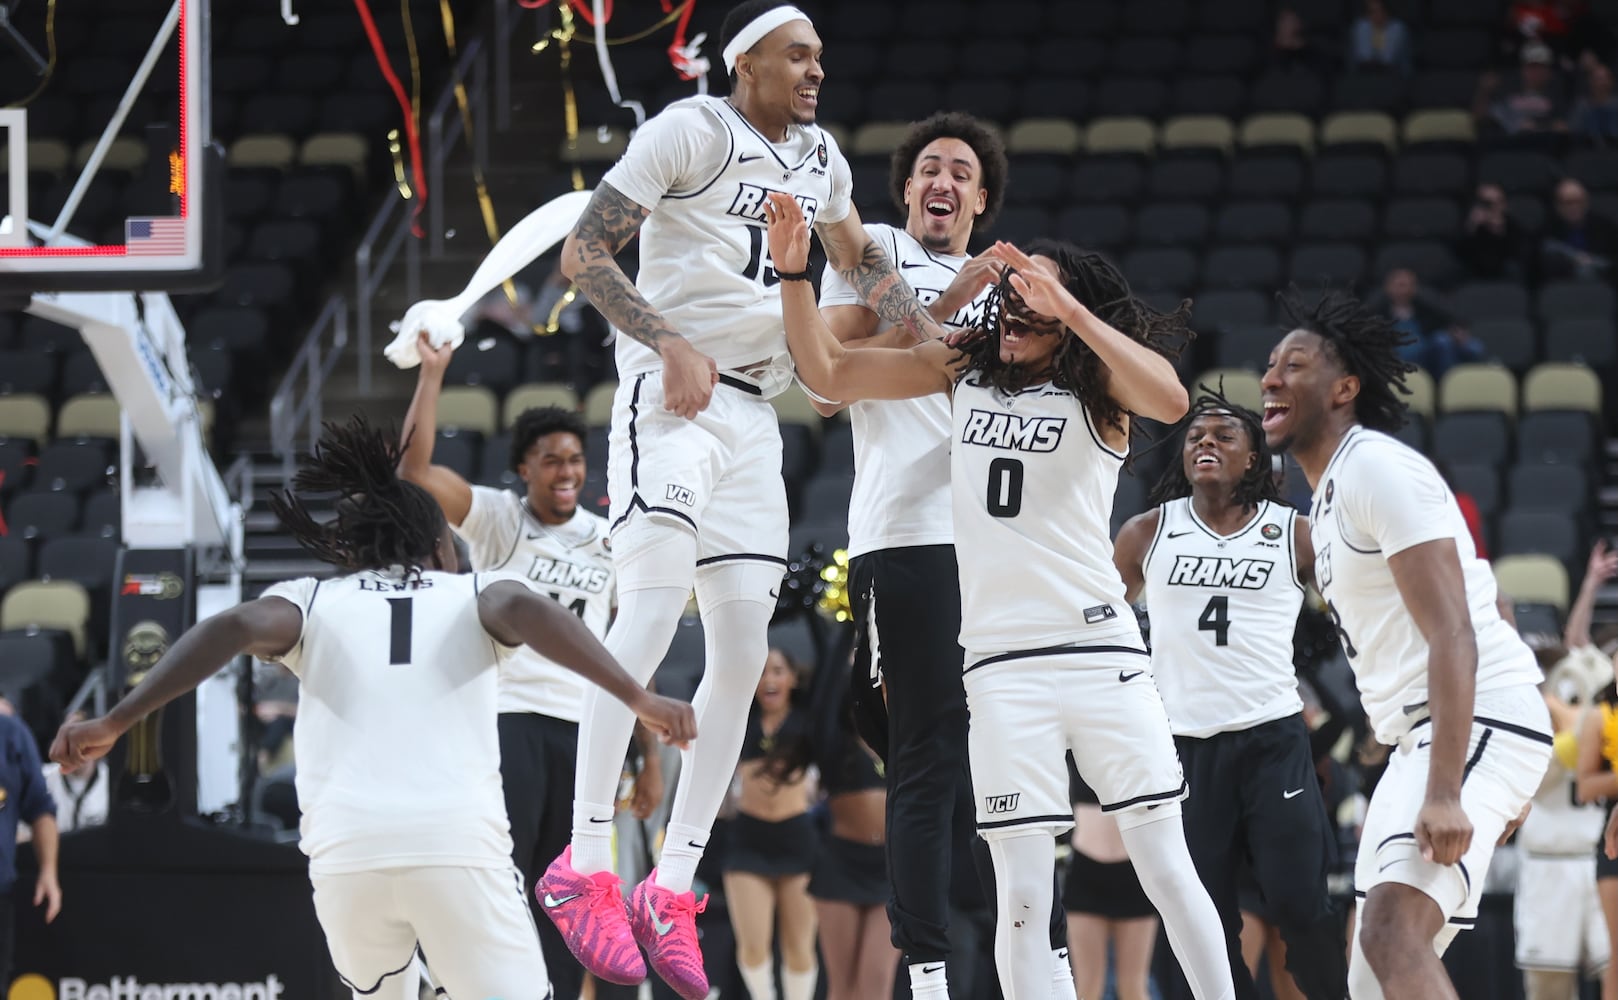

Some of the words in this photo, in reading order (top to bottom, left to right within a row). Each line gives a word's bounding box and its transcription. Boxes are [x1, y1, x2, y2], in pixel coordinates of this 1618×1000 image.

[962, 408, 1068, 453] RAMS
[666, 483, 696, 507] VCU
[986, 457, 1024, 518] 0
[527, 555, 610, 594] RAMS
[1167, 555, 1275, 590] RAMS
[384, 597, 413, 665] 1
[1198, 595, 1232, 647] 4
[985, 792, 1020, 814] VCU
